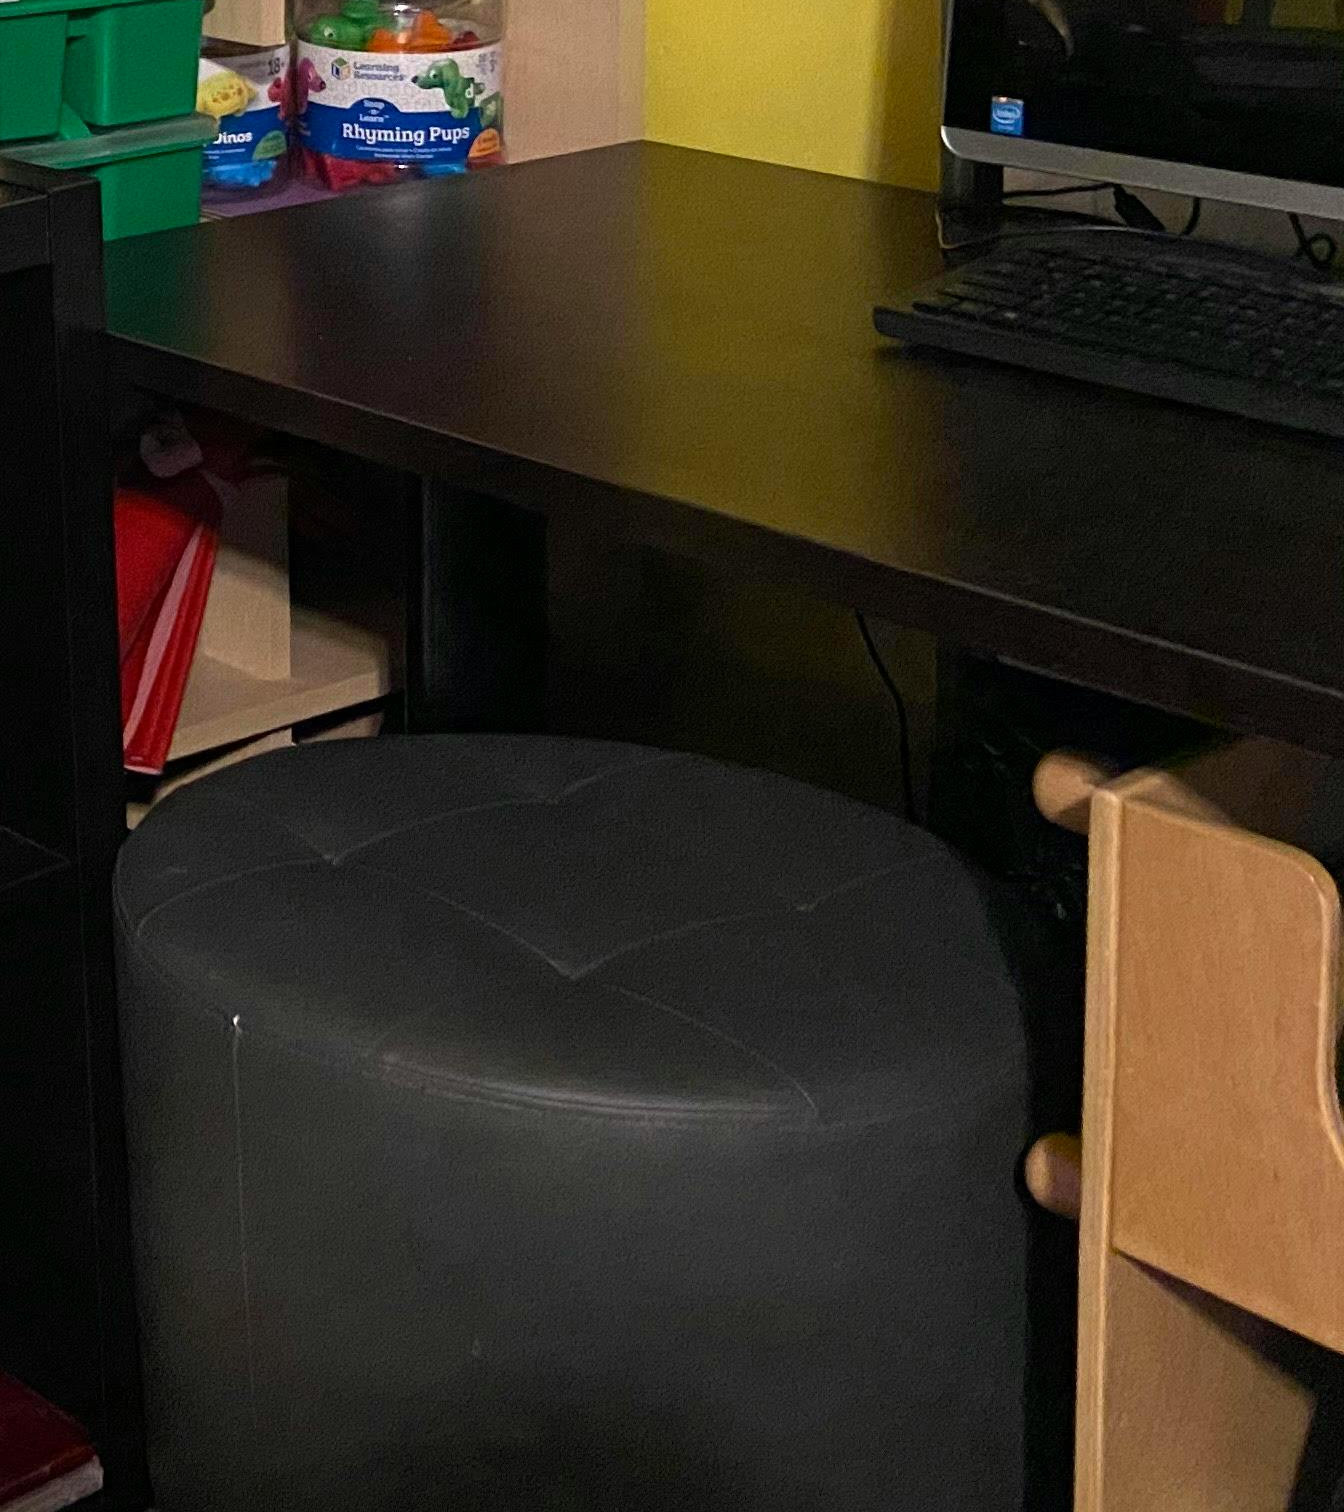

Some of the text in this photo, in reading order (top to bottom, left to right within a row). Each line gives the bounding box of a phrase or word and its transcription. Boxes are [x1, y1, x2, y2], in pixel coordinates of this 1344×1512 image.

[354, 62, 399, 72] Learning
[354, 71, 404, 81] Resources
[343, 123, 425, 146] Rhyming
[429, 125, 470, 144] Pups
